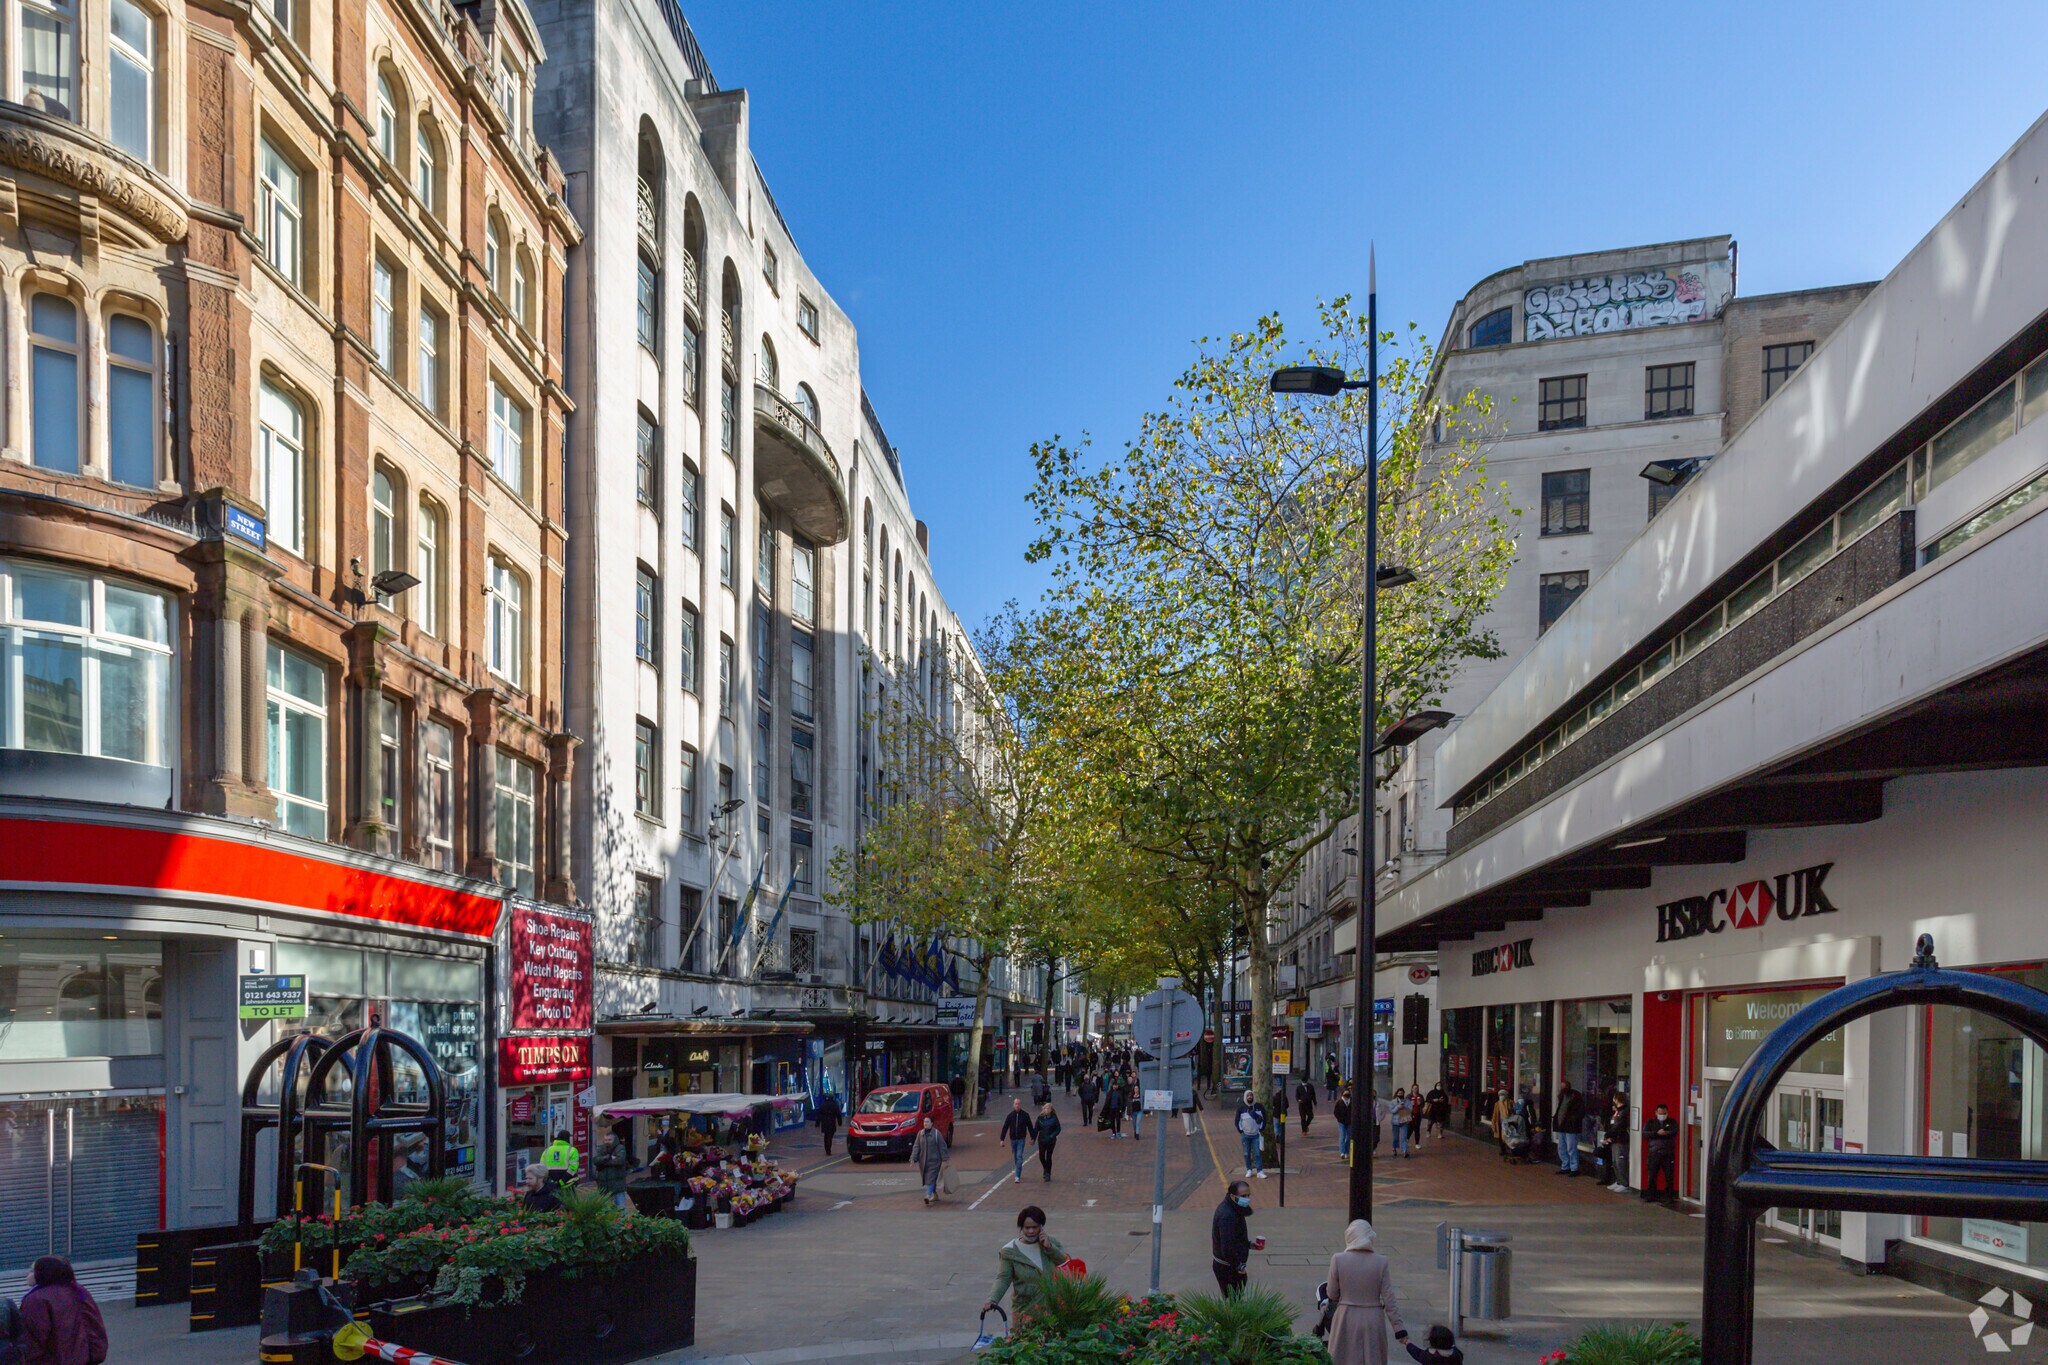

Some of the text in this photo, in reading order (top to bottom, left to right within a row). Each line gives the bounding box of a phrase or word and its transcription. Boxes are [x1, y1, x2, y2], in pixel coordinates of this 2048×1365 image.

[237, 514, 256, 529] NEW
[230, 520, 261, 541] STREET
[1656, 862, 1839, 943] HSBC UK
[526, 918, 580, 941] Shoe Repairs
[529, 940, 578, 963] Key Cutting
[1472, 938, 1535, 977] HSBC UK
[523, 960, 582, 982] Watch Repairs
[244, 991, 264, 999] 0121
[265, 991, 281, 999] 643
[533, 983, 574, 1002] Engraving
[252, 1007, 294, 1016] TO LET
[453, 1009, 476, 1022] prime
[536, 1004, 572, 1019] Photo ID
[428, 1023, 476, 1036] retail space
[1725, 1028, 1734, 1040] to
[435, 1041, 475, 1058] TO LET
[518, 1045, 580, 1065] TIMPSON
[532, 1068, 547, 1076] Quality
